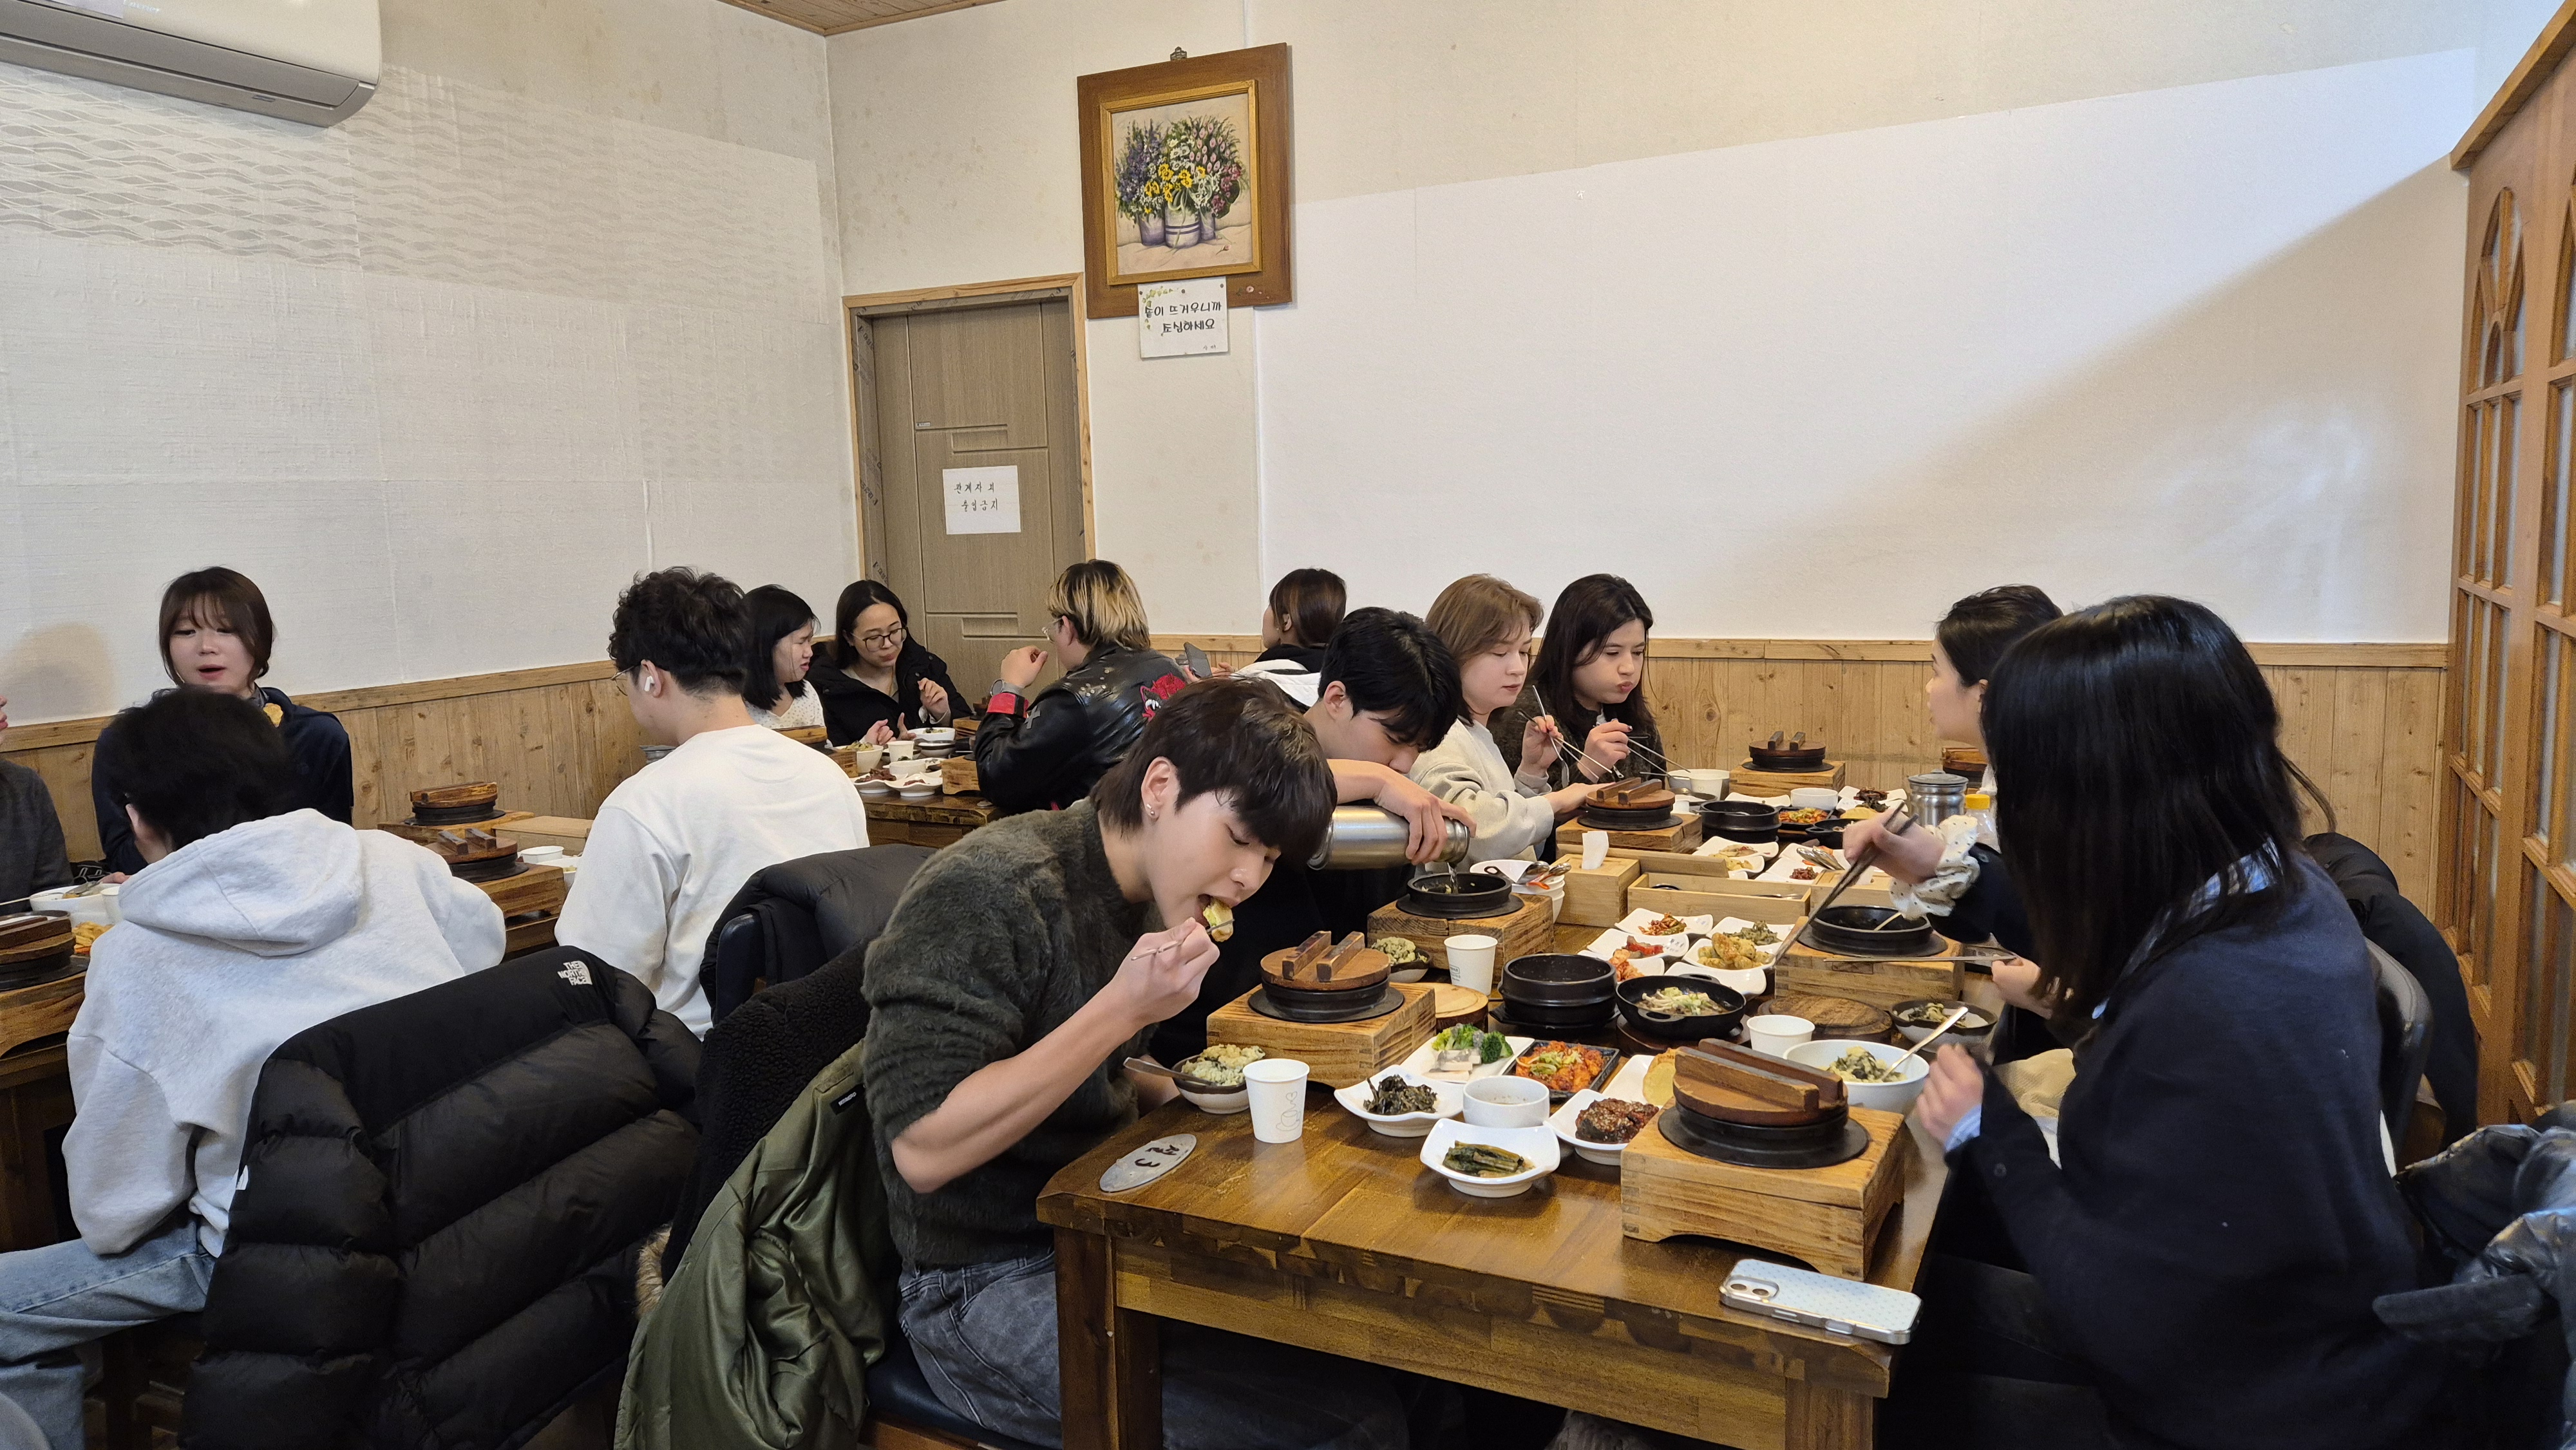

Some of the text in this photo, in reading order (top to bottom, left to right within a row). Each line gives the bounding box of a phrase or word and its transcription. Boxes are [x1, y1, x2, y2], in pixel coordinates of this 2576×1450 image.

[1170, 301, 1222, 315] 뜨거우니까
[1163, 319, 1215, 333] 조심하세요
[954, 481, 994, 494] 관계자 외
[961, 497, 999, 512] 출입금지
[563, 961, 582, 970] THE
[557, 968, 585, 979] NORTH
[568, 977, 587, 986] FACE
